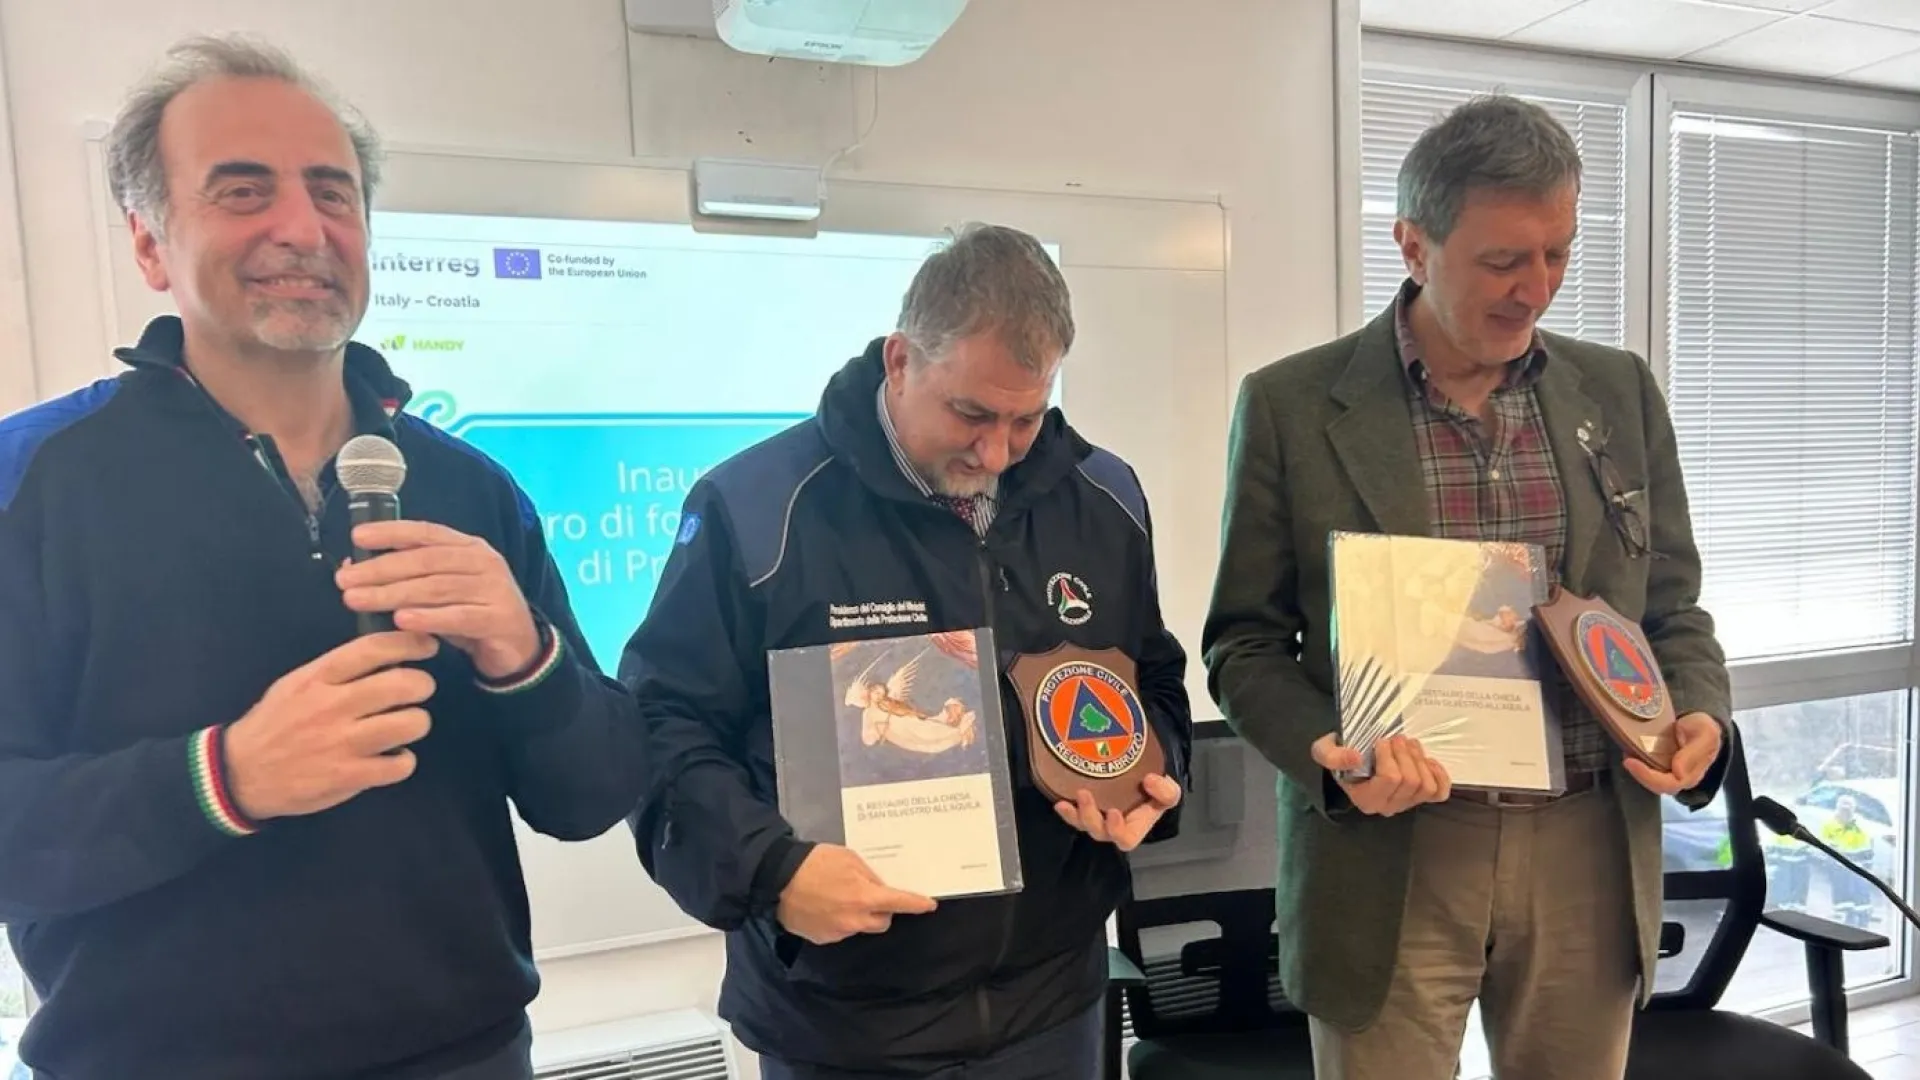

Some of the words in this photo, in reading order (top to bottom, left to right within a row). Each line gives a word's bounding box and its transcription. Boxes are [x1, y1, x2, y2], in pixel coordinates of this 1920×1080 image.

[804, 40, 843, 50] EPSON
[547, 254, 600, 265] Co-funded
[602, 256, 615, 267] by
[548, 267, 565, 276] the
[567, 267, 615, 278] European
[617, 268, 647, 278] Union
[375, 293, 411, 310] Italy
[426, 295, 480, 308] Croatia
[412, 339, 465, 351] HANDY
[542, 511, 587, 540] ro
[601, 504, 634, 540] di
[577, 550, 612, 585] di
[1041, 666, 1095, 702] PROTEZIONE
[1097, 670, 1130, 696] CIVILE
[1055, 742, 1106, 773] REGIONE
[1108, 732, 1143, 773] ABRUZZO
